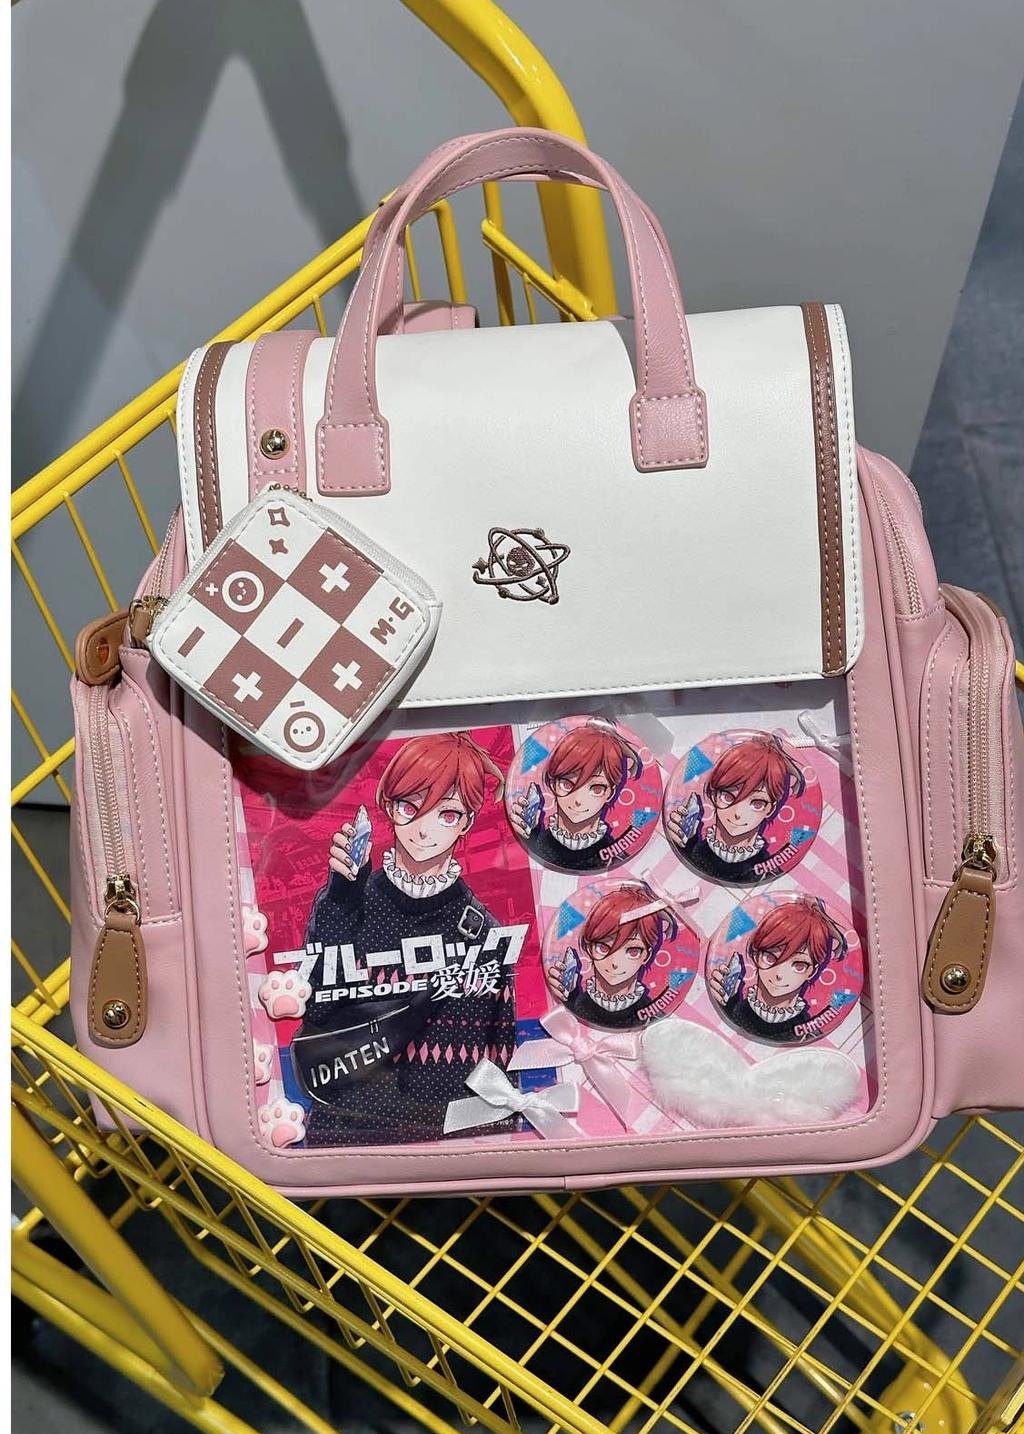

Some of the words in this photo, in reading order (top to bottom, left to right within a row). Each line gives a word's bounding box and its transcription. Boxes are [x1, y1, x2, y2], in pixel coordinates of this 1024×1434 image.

[599, 827, 642, 862] CHIGIRI
[754, 844, 799, 876] CHIGIRI
[273, 923, 529, 986] ブルーロック
[315, 979, 428, 1004] EPISODE
[429, 959, 501, 1002] 愛媛
[636, 988, 679, 1021] CHIGIRI
[794, 1007, 840, 1038] CHIGIRI
[309, 1036, 391, 1089] IDATEN
